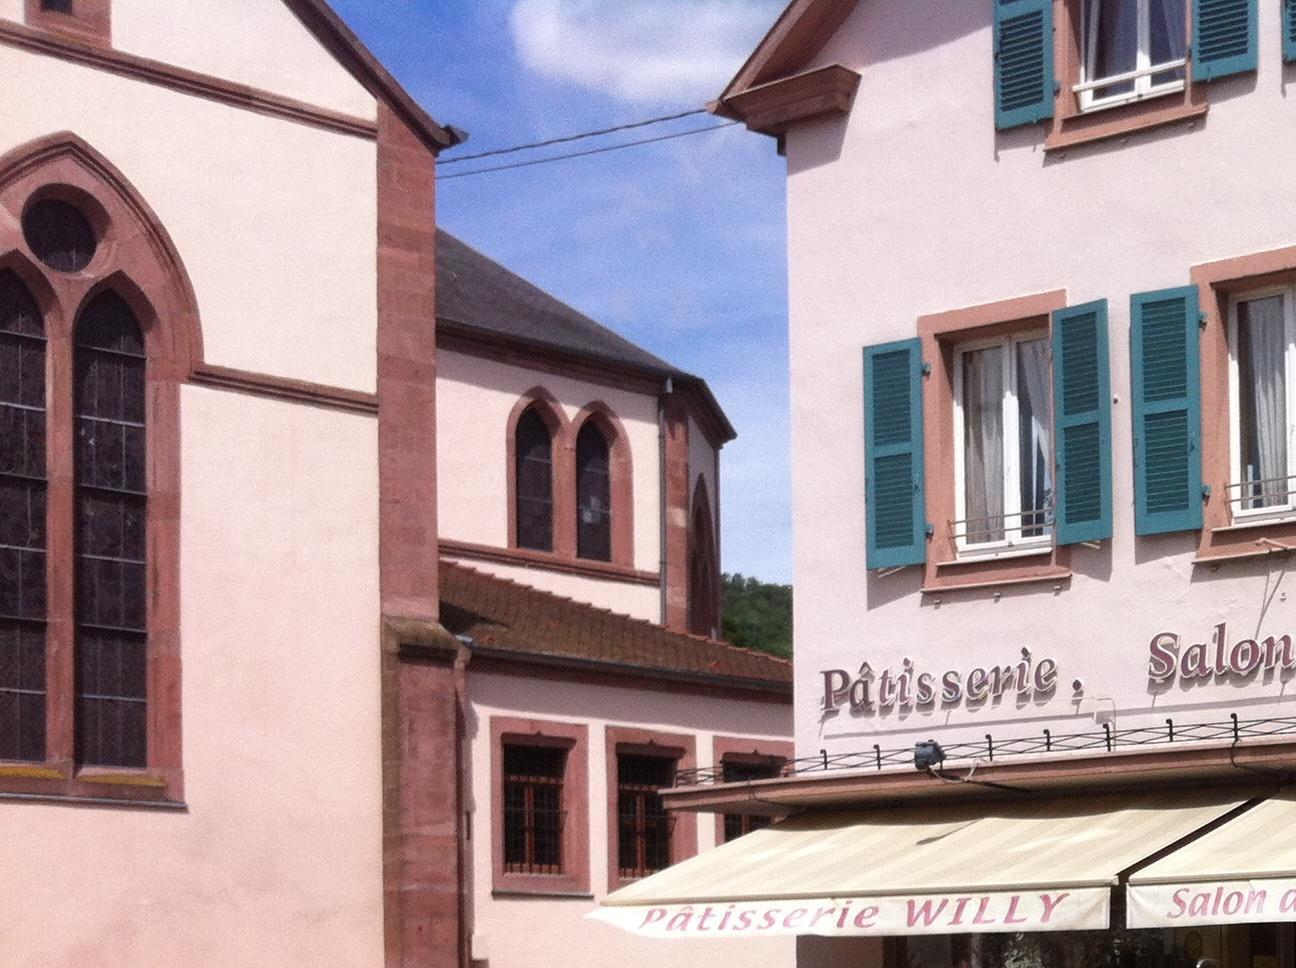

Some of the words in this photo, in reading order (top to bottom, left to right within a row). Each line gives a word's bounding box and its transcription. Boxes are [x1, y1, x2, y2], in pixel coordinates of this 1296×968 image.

[1148, 622, 1296, 682] Salon
[640, 900, 880, 932] Pâtisserie
[905, 893, 1071, 927] WILLY
[1167, 886, 1268, 919] Salon
